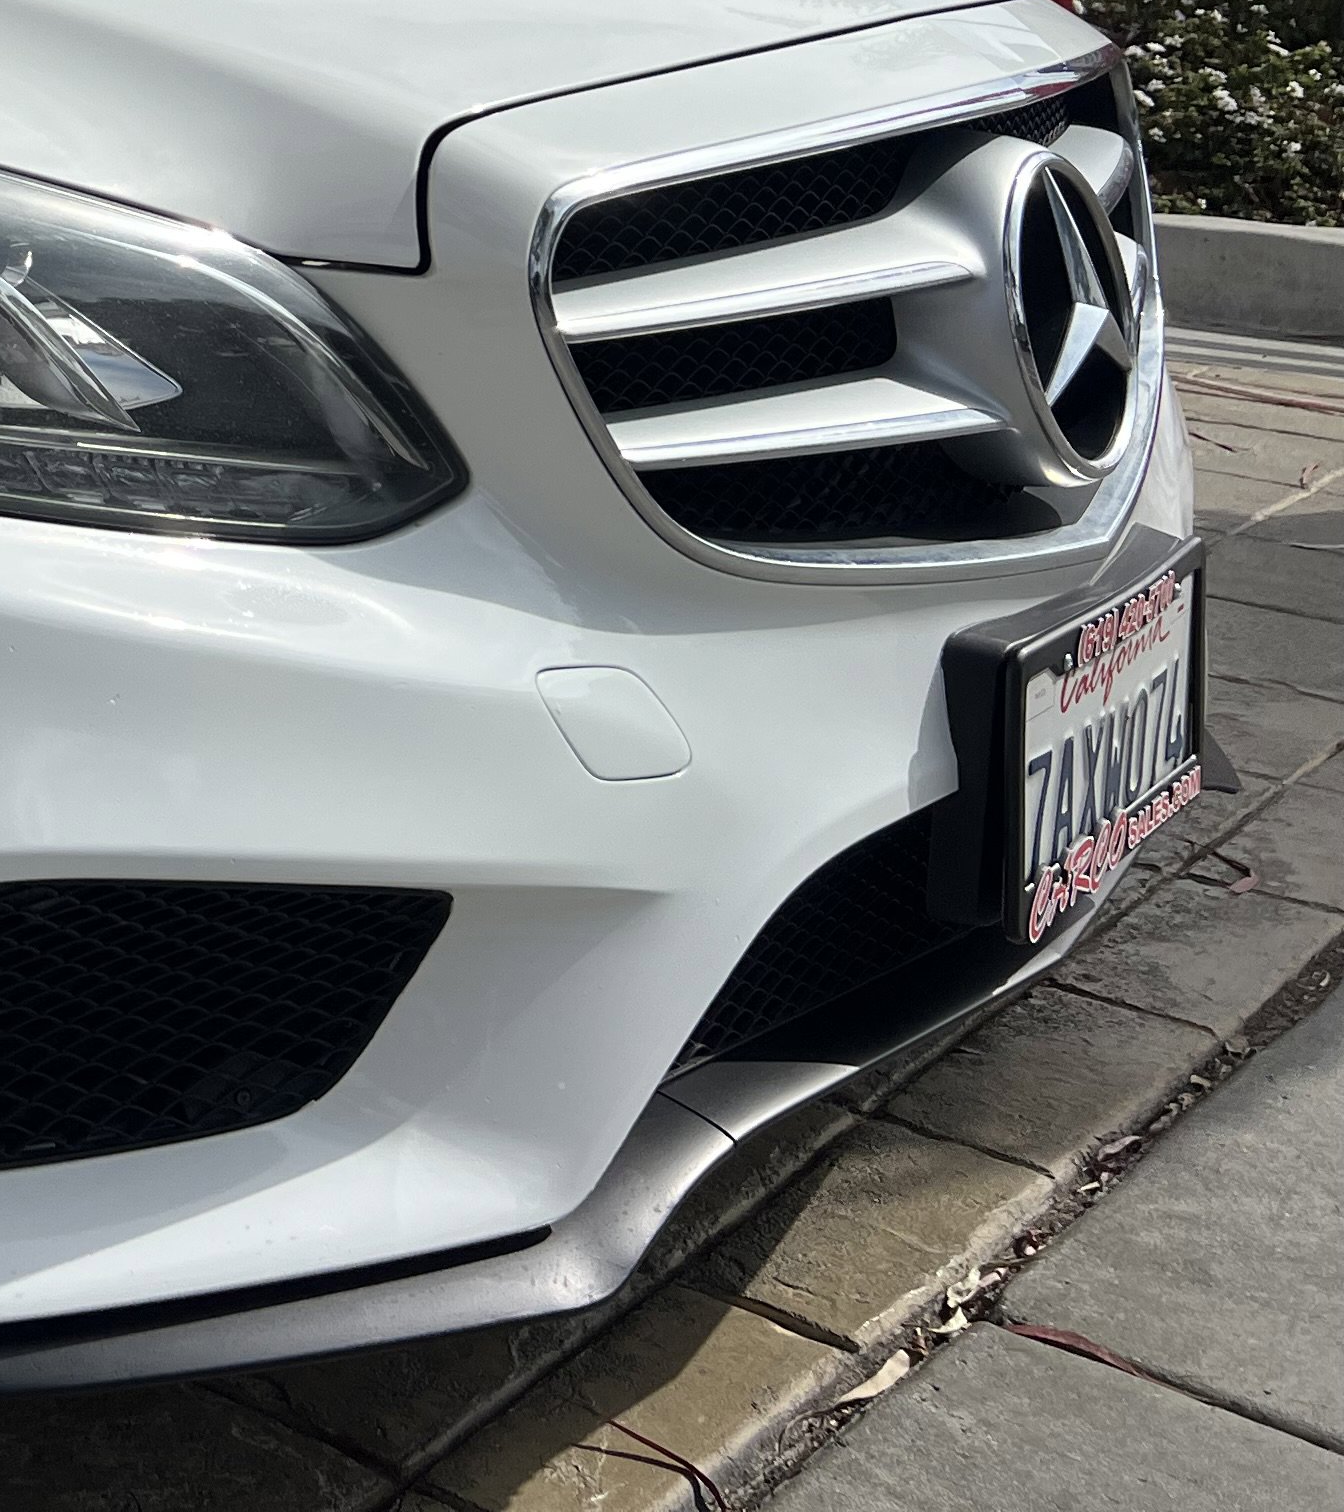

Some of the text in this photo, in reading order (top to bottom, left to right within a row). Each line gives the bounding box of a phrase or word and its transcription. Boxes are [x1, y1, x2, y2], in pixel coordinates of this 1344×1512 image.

[1061, 615, 1170, 713] California
[1077, 608, 1119, 668] (619)
[1128, 765, 1201, 850] SALES.COM
